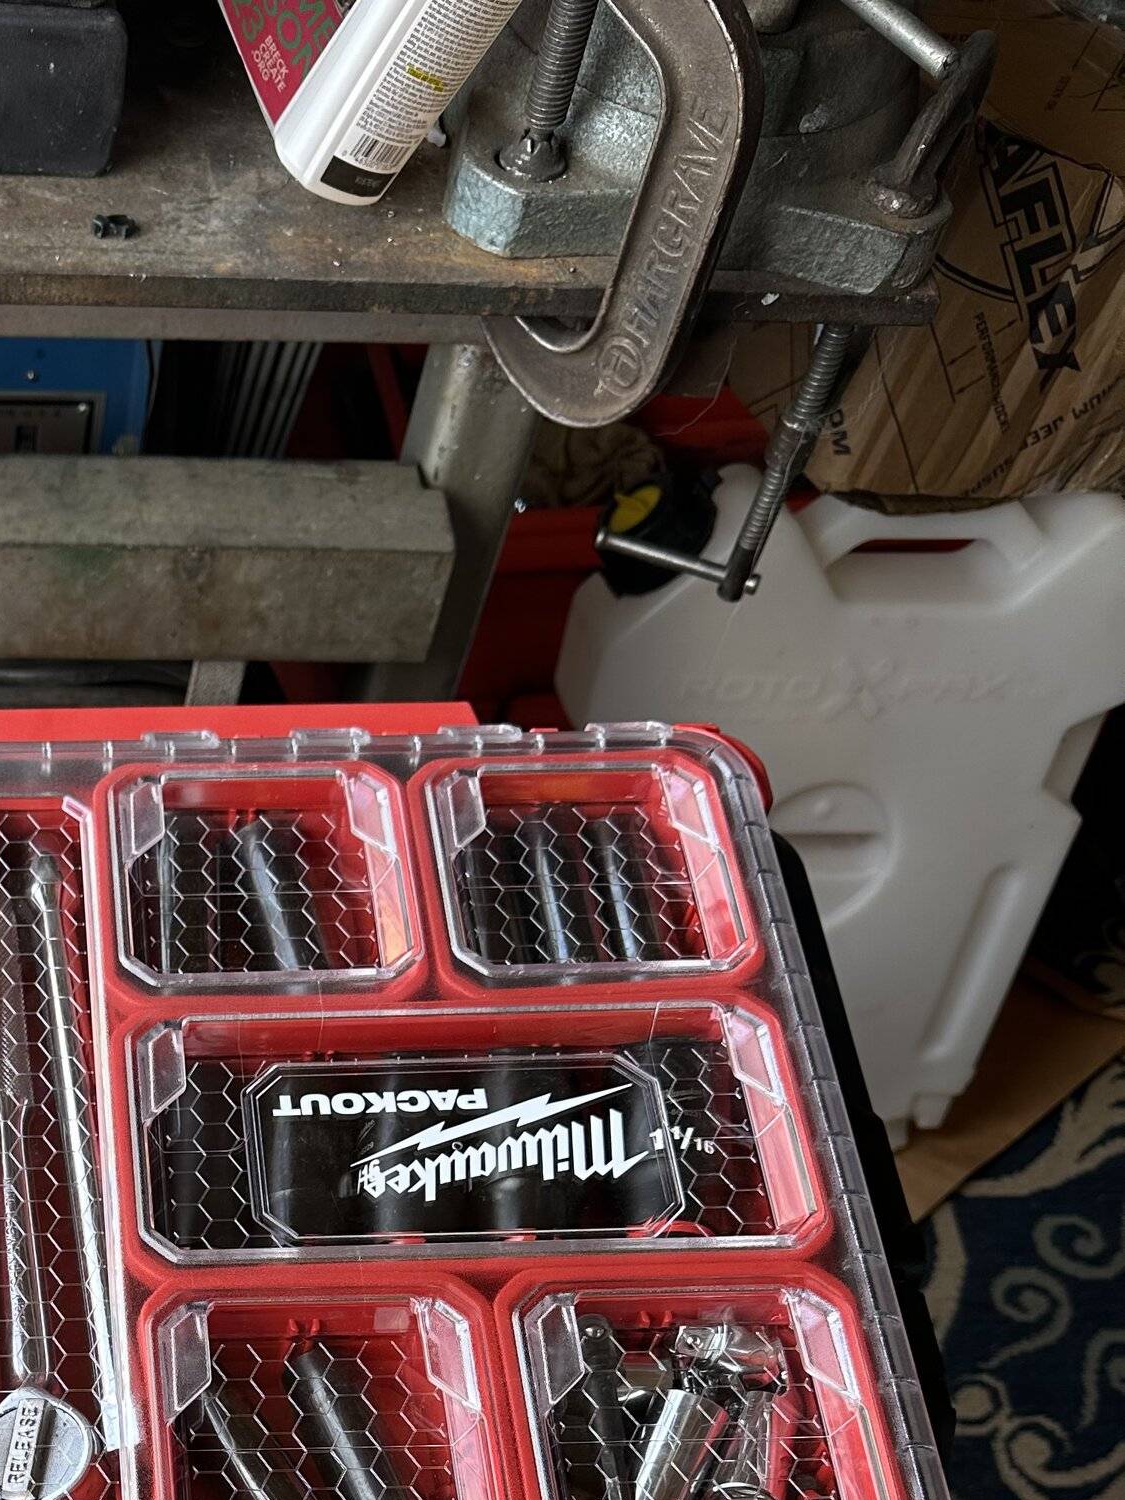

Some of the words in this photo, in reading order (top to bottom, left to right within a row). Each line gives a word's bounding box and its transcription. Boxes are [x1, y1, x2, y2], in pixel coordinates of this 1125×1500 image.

[259, 43, 287, 93] CREATE
[264, 35, 290, 79] BRECK
[622, 98, 731, 346] HARGRAVE
[273, 1087, 488, 1117] PACKOUT
[371, 1107, 650, 1203] Milwaukee
[7, 1406, 39, 1484] RELEASE
